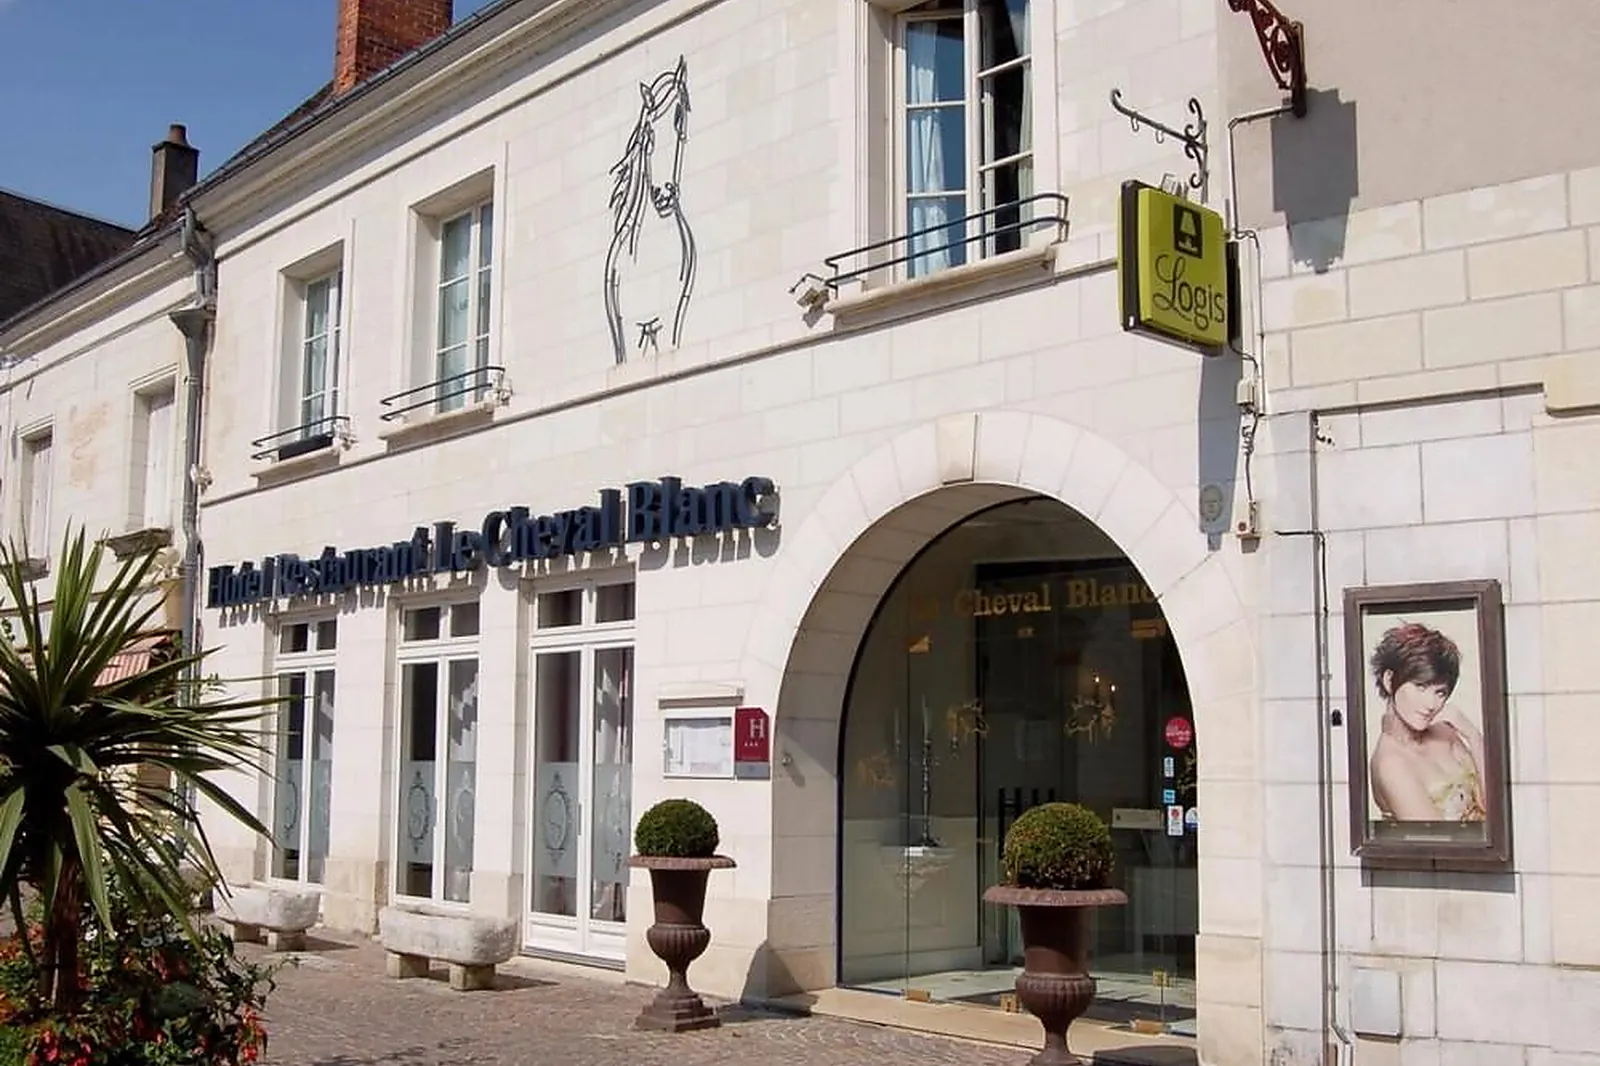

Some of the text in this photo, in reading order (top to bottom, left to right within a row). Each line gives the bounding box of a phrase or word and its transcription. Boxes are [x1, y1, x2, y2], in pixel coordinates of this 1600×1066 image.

[1152, 254, 1226, 332] Logis
[276, 526, 431, 601] Restaurant
[433, 521, 483, 572] Le
[481, 488, 623, 569] Cheval
[624, 476, 780, 544] Blanc
[954, 582, 1052, 618] Cheval
[749, 717, 764, 739] H
